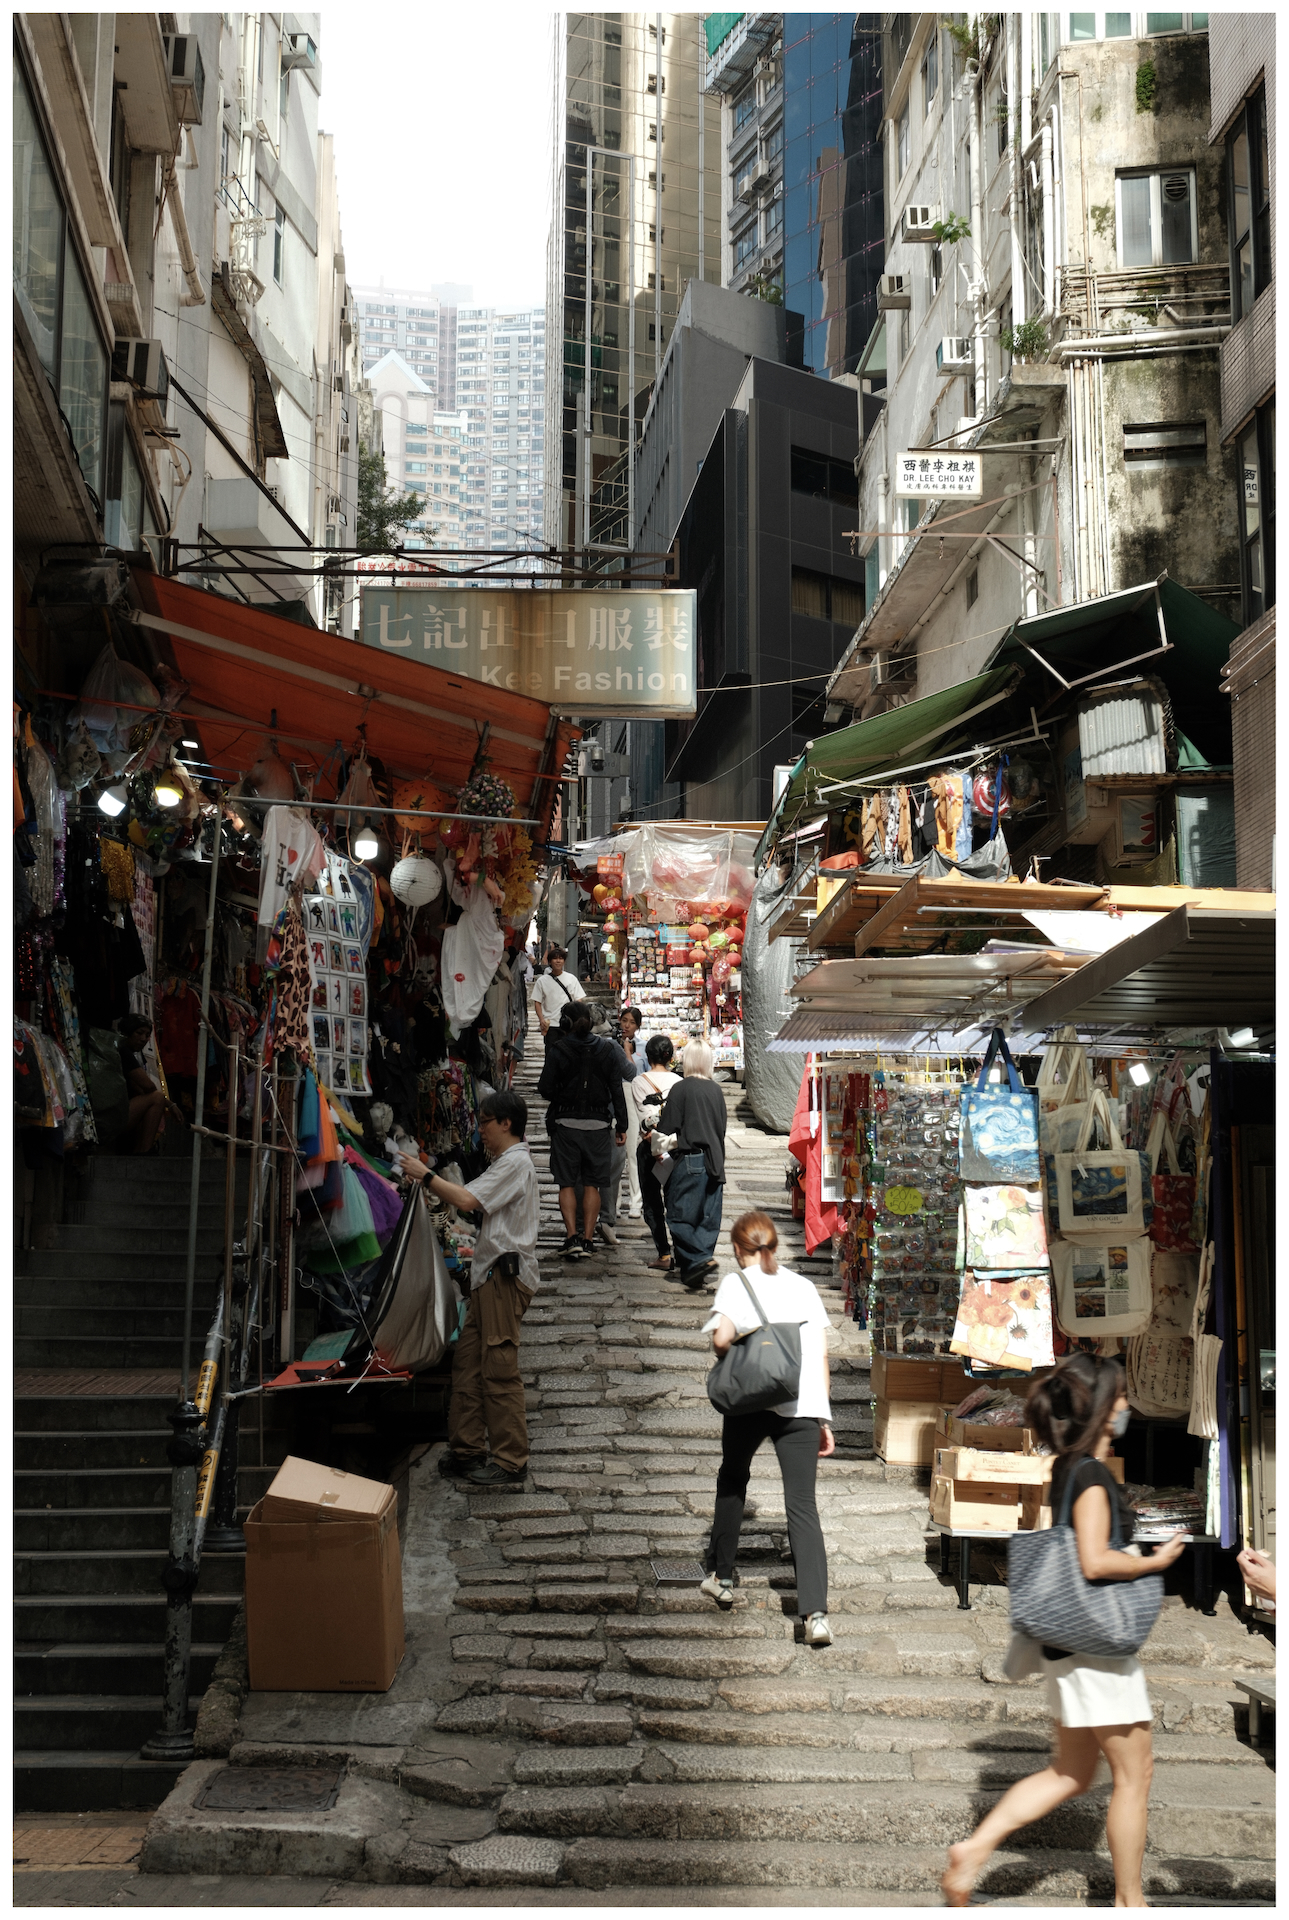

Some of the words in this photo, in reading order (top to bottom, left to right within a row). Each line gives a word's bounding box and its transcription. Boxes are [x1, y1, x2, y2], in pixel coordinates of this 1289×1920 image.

[903, 473, 917, 482] DR.
[919, 474, 935, 482] LEE
[938, 474, 955, 483] CHO
[958, 475, 975, 483] KAY
[367, 603, 690, 652] 七記出口服裝
[481, 665, 543, 691] Kee
[554, 665, 687, 691] Fashion
